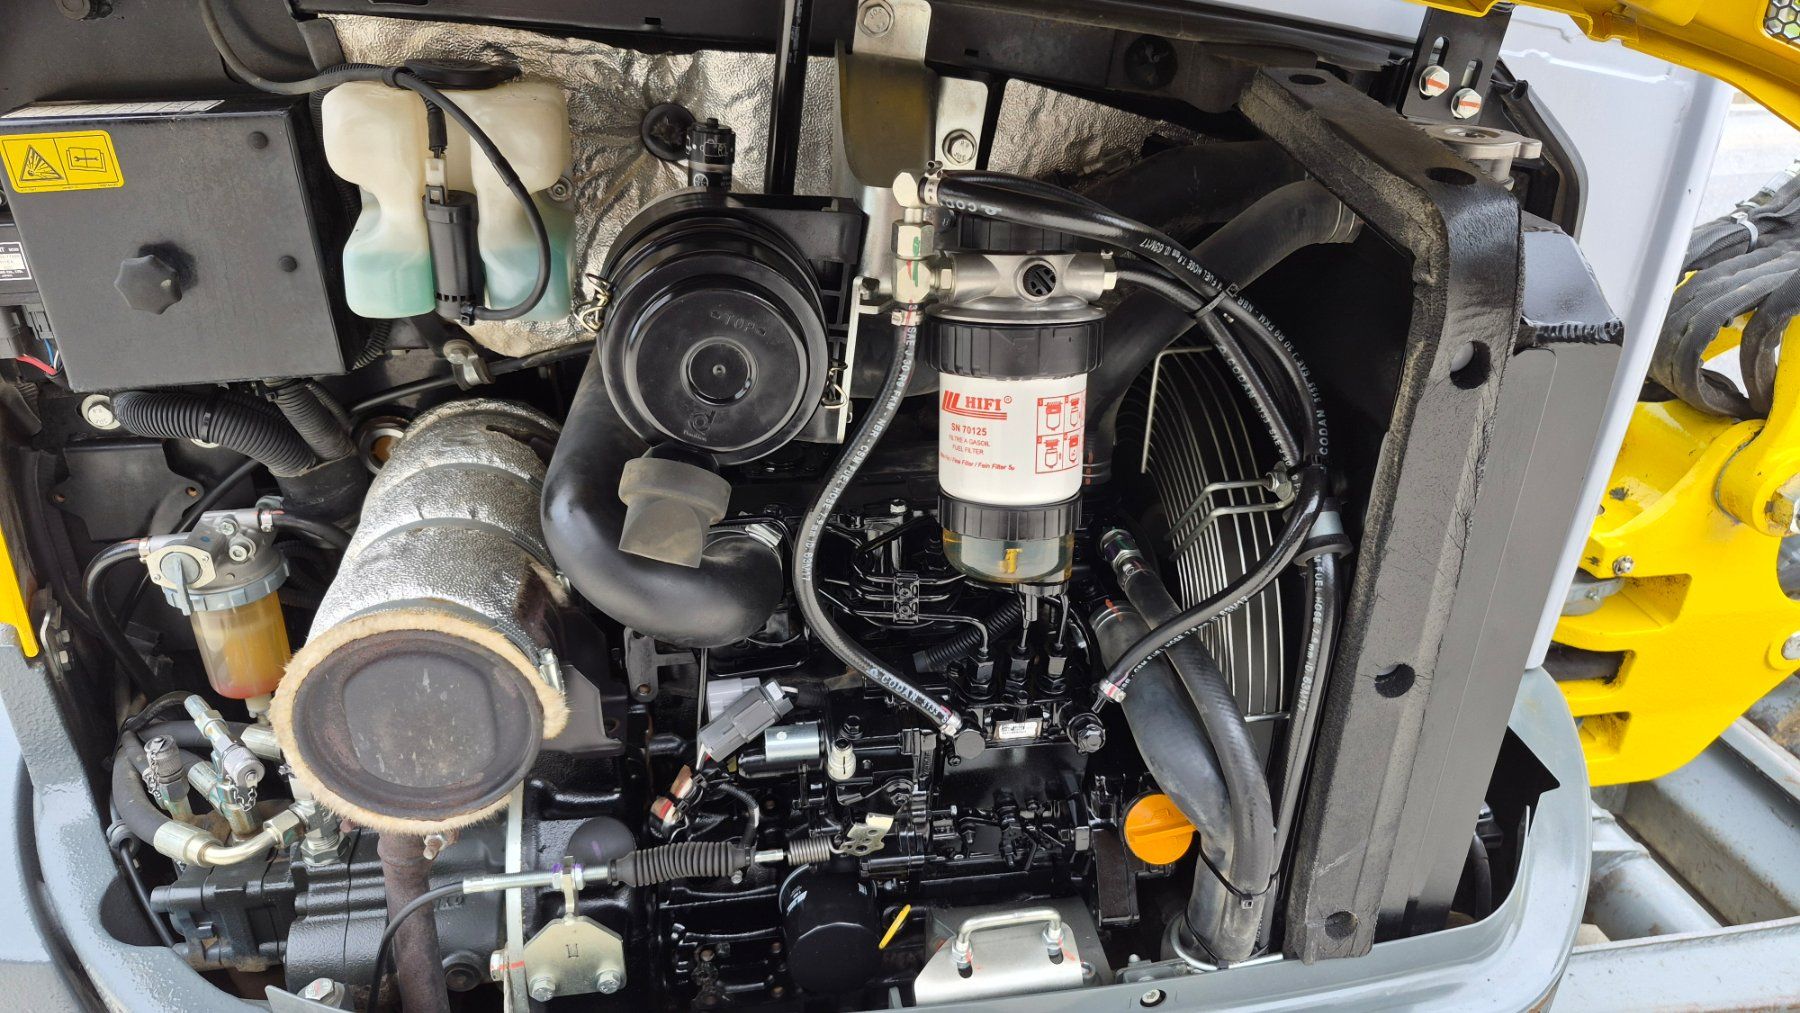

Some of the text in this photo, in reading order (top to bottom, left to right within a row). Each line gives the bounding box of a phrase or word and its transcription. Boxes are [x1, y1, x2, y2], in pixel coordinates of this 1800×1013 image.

[940, 199, 977, 212] COD
[1186, 260, 1202, 275] HOSE
[1203, 269, 1217, 287] FUEL
[1237, 296, 1254, 313] NBR
[1258, 313, 1276, 332] FKM
[906, 327, 917, 346] SAE
[901, 359, 911, 371] 30
[896, 374, 907, 388] R9
[886, 389, 902, 410] FKM
[965, 396, 1002, 411] HIFI
[1226, 359, 1255, 398] CODAN
[1268, 428, 1282, 447] SAE
[870, 418, 887, 438] NBR
[951, 422, 988, 437] SN 70125
[1316, 409, 1328, 455] CODAN
[948, 434, 964, 443] FILTRE
[852, 445, 869, 464] CSM
[952, 444, 984, 455] FUEL FILTER
[838, 465, 857, 485] FUEL
[823, 487, 841, 509] HOSE
[1314, 566, 1324, 592] FUEL
[1312, 596, 1323, 624] HOSE
[881, 675, 940, 716] CODAN 3133
